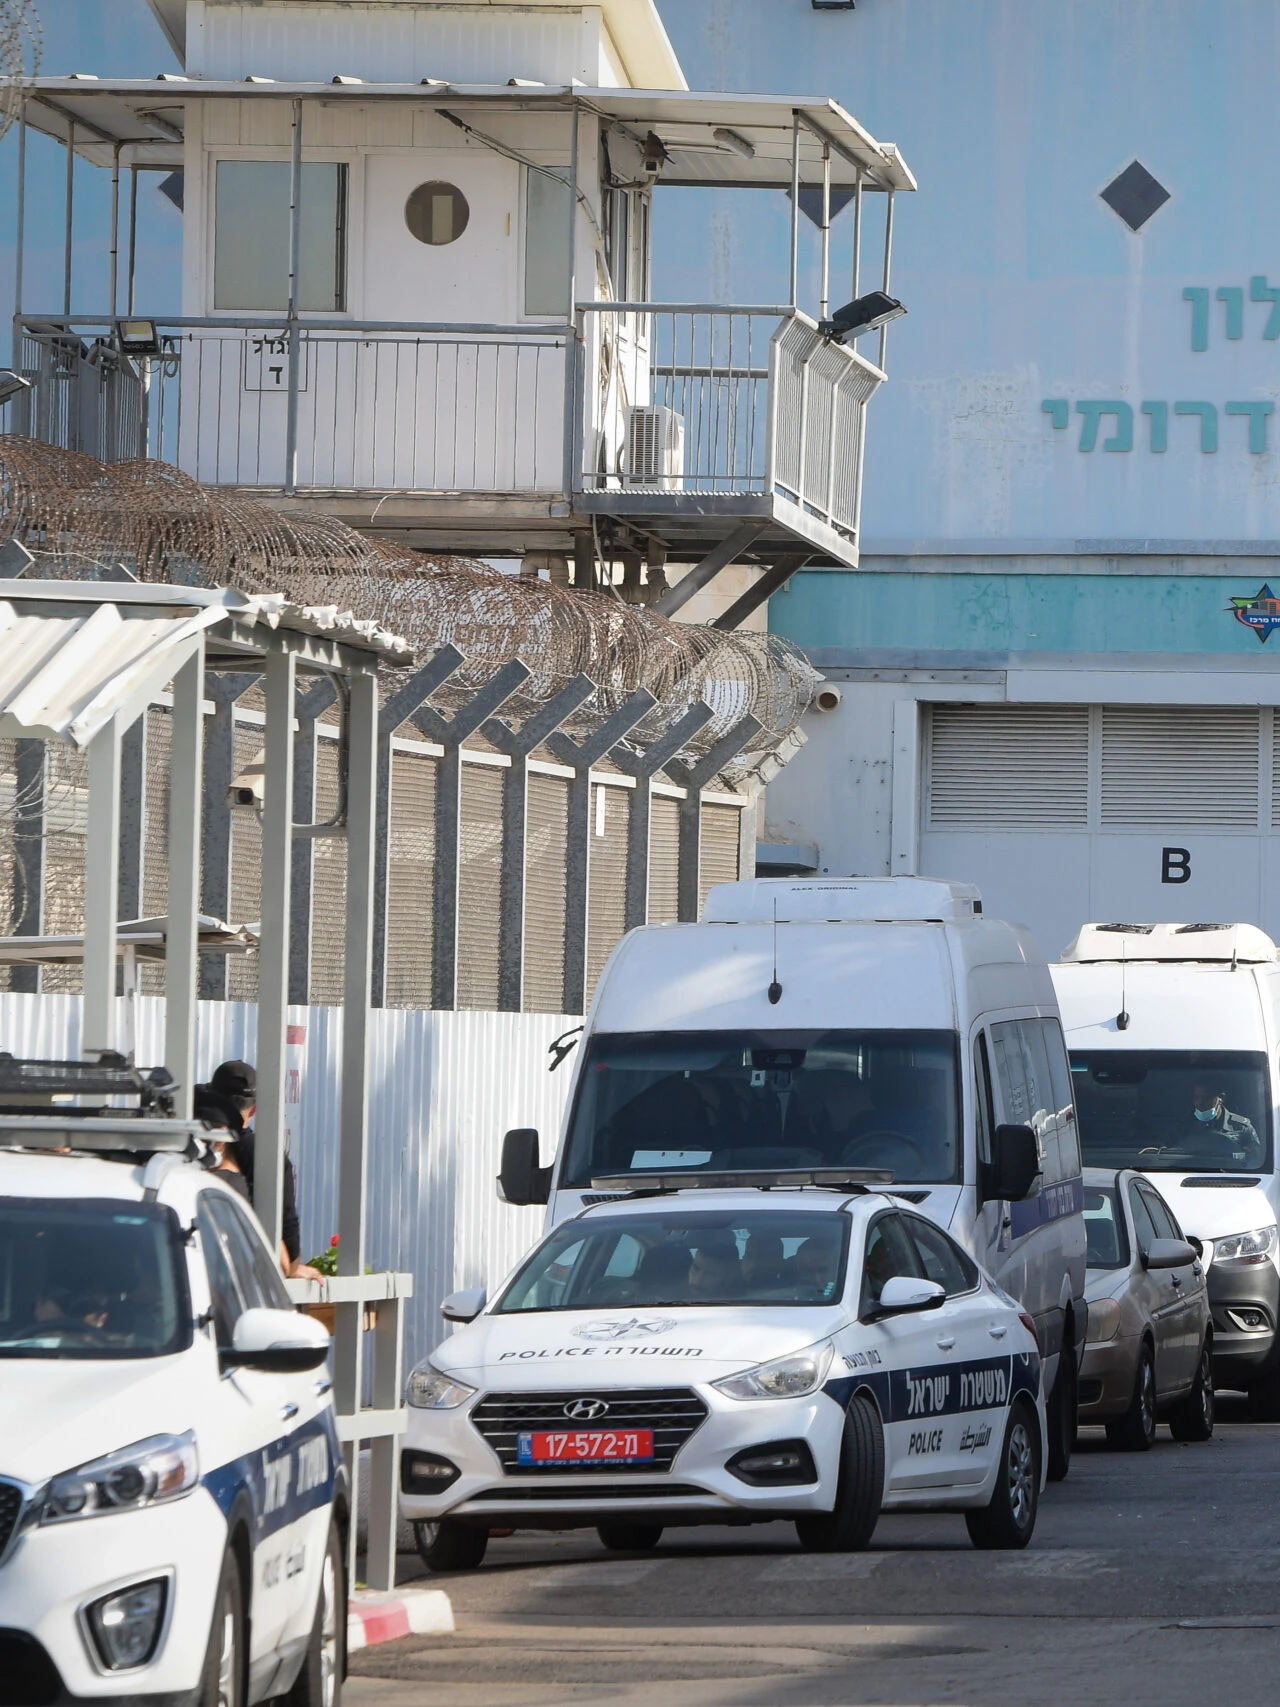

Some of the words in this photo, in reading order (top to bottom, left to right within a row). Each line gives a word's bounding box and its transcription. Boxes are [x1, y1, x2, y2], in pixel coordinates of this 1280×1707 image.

[252, 334, 290, 355] גדל
[268, 366, 284, 385] ד
[1041, 399, 1275, 454] דרומי
[1162, 847, 1192, 884] B
[499, 1347, 598, 1361] POLICE
[604, 1346, 703, 1357] משטרה
[906, 1370, 950, 1415] ישראל
[960, 1368, 1006, 1408] משטרת
[908, 1429, 943, 1456] POLICE
